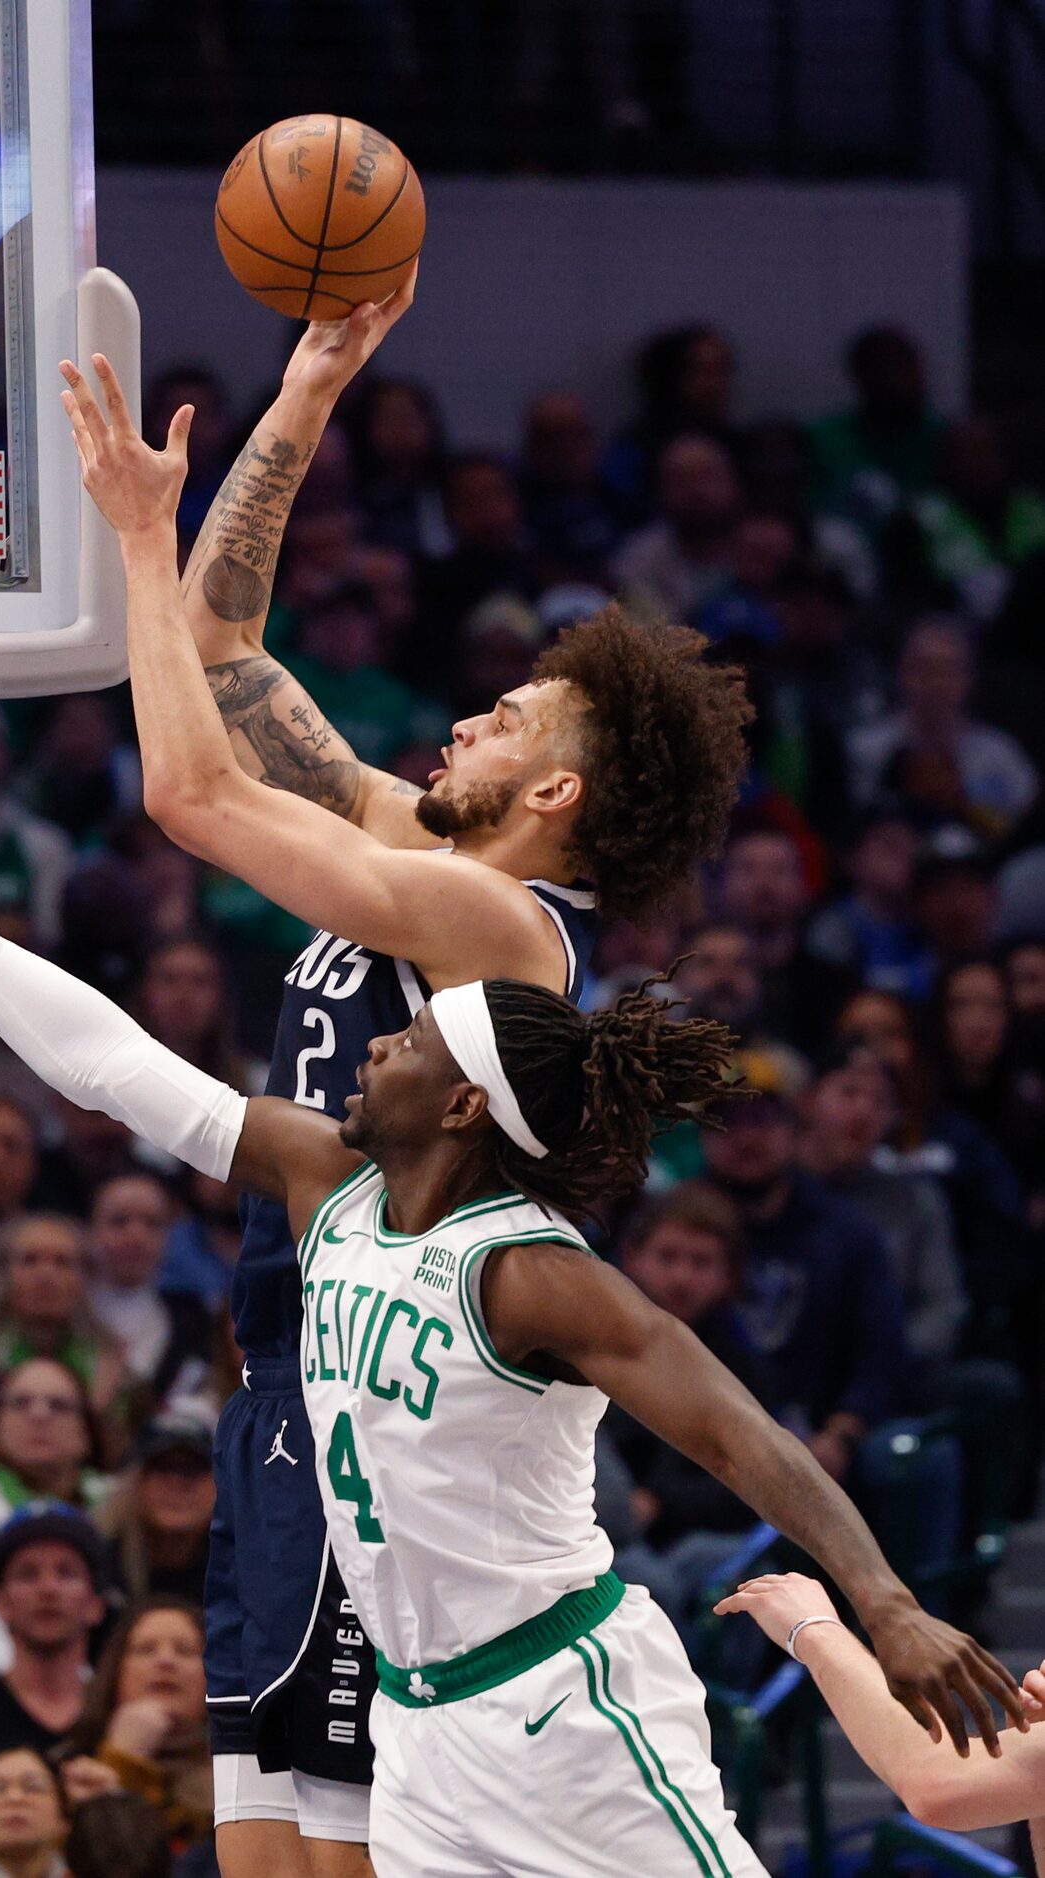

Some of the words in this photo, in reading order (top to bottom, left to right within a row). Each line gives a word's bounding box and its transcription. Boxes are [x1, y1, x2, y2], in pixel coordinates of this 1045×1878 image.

[294, 1007, 336, 1110] 2
[413, 1266, 453, 1293] PRINT
[422, 1246, 456, 1277] VISTA
[304, 1279, 454, 1421] CELTICS
[327, 1411, 386, 1543] 4
